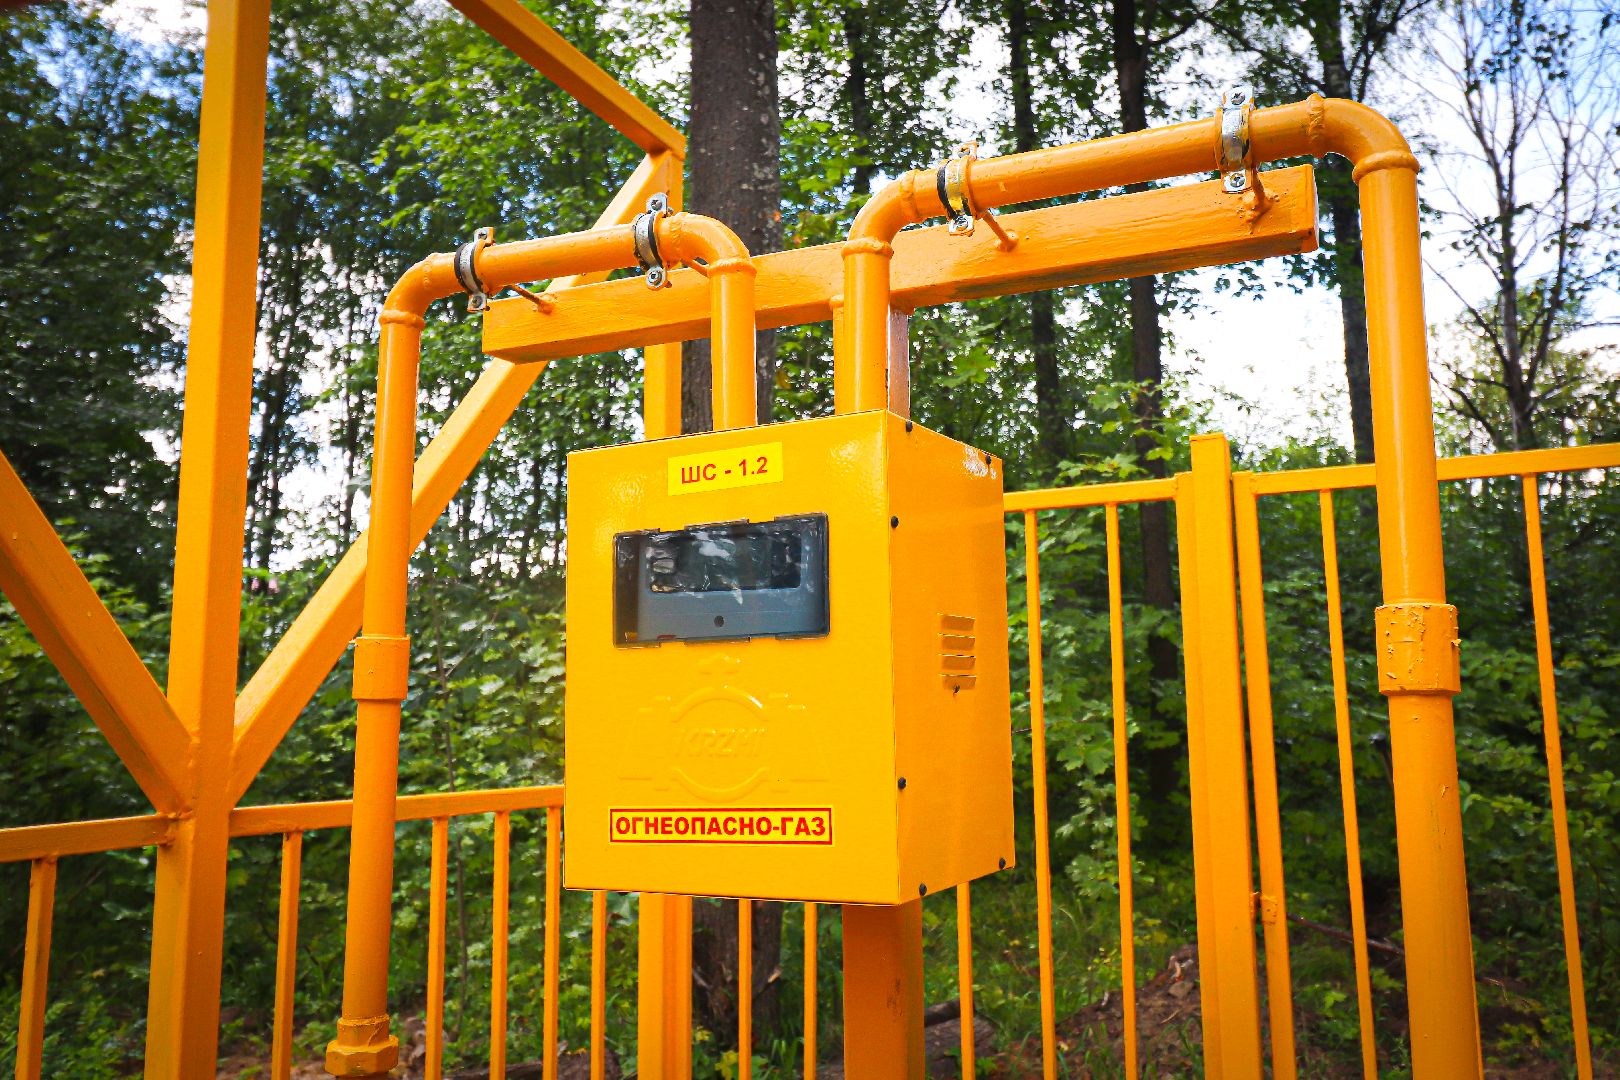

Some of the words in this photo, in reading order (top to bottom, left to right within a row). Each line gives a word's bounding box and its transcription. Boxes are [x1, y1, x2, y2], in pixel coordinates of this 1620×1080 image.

[681, 463, 717, 484] ШС
[738, 456, 768, 476] 1.2
[615, 816, 826, 836] ОГНЕОПАСНО-ГАЗ
